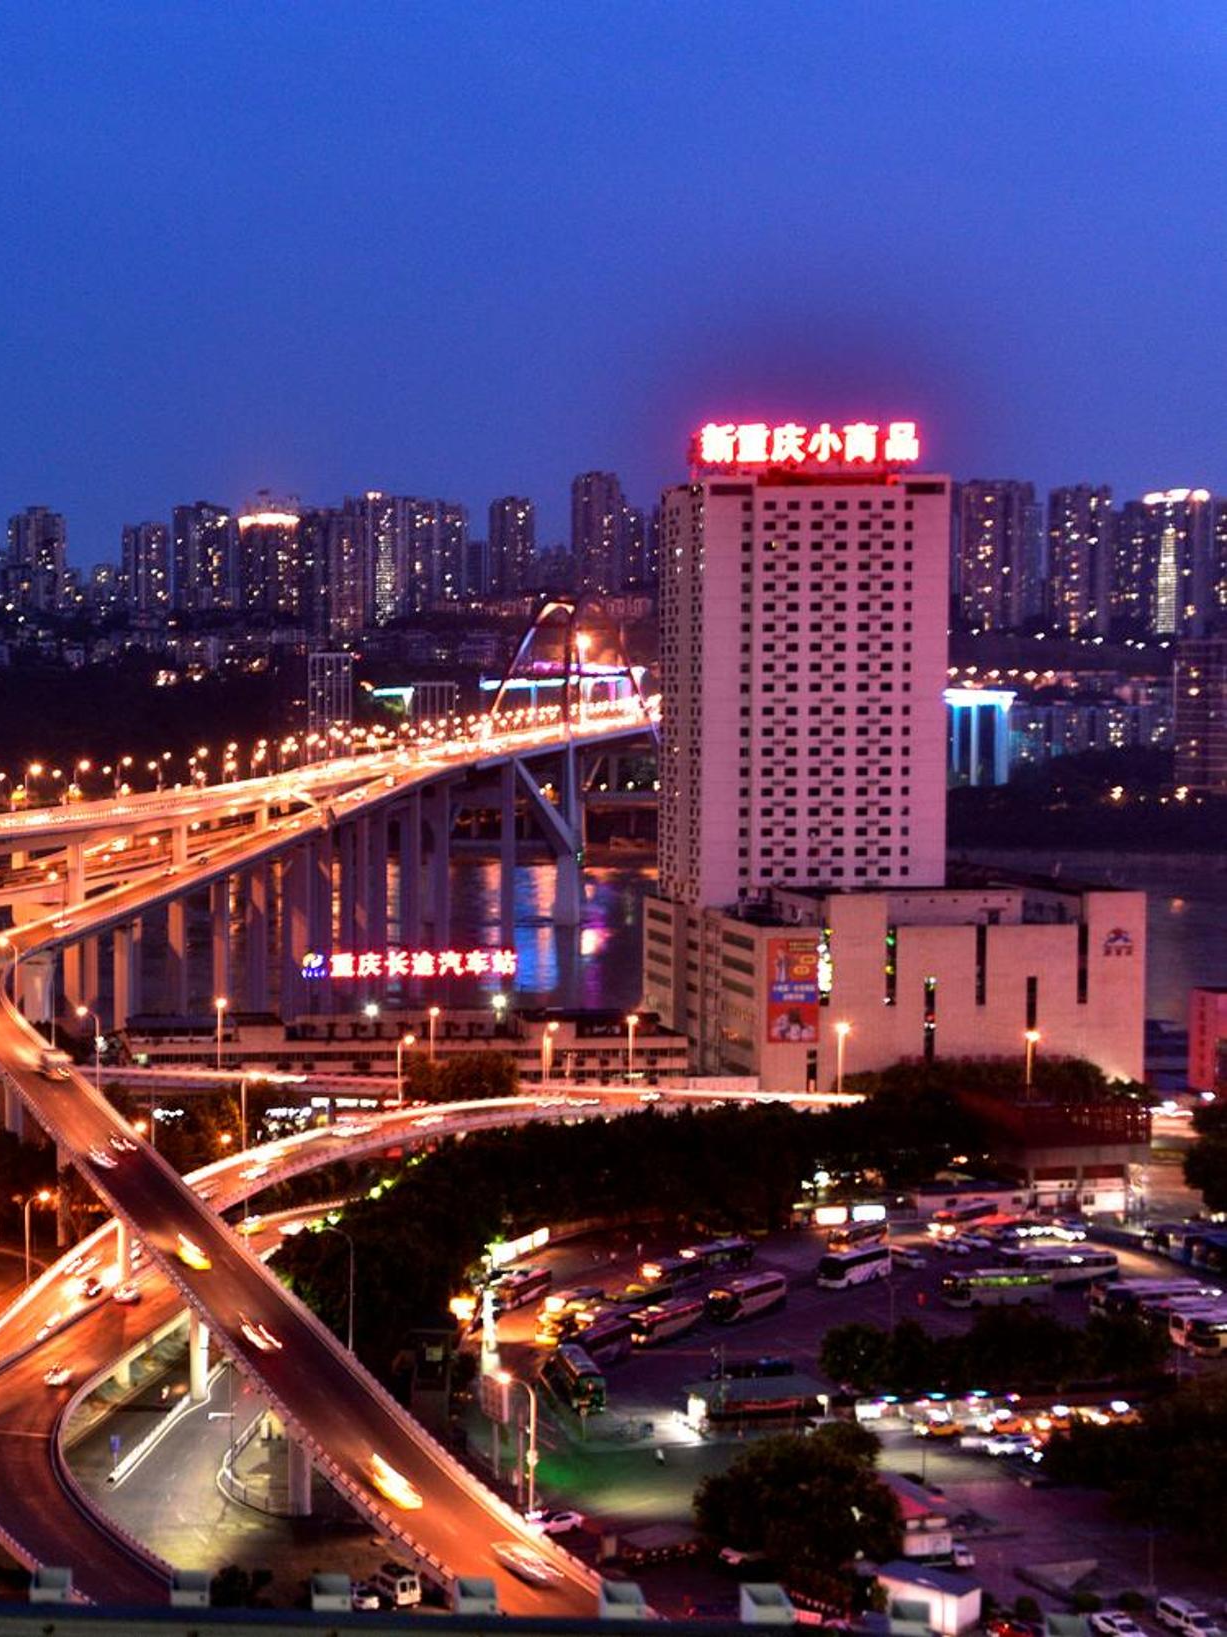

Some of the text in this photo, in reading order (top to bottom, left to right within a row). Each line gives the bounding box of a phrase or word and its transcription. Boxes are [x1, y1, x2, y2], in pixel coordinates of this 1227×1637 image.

[701, 422, 920, 462] 新重庆小商品
[329, 950, 518, 977] 重庆长途汽车站
